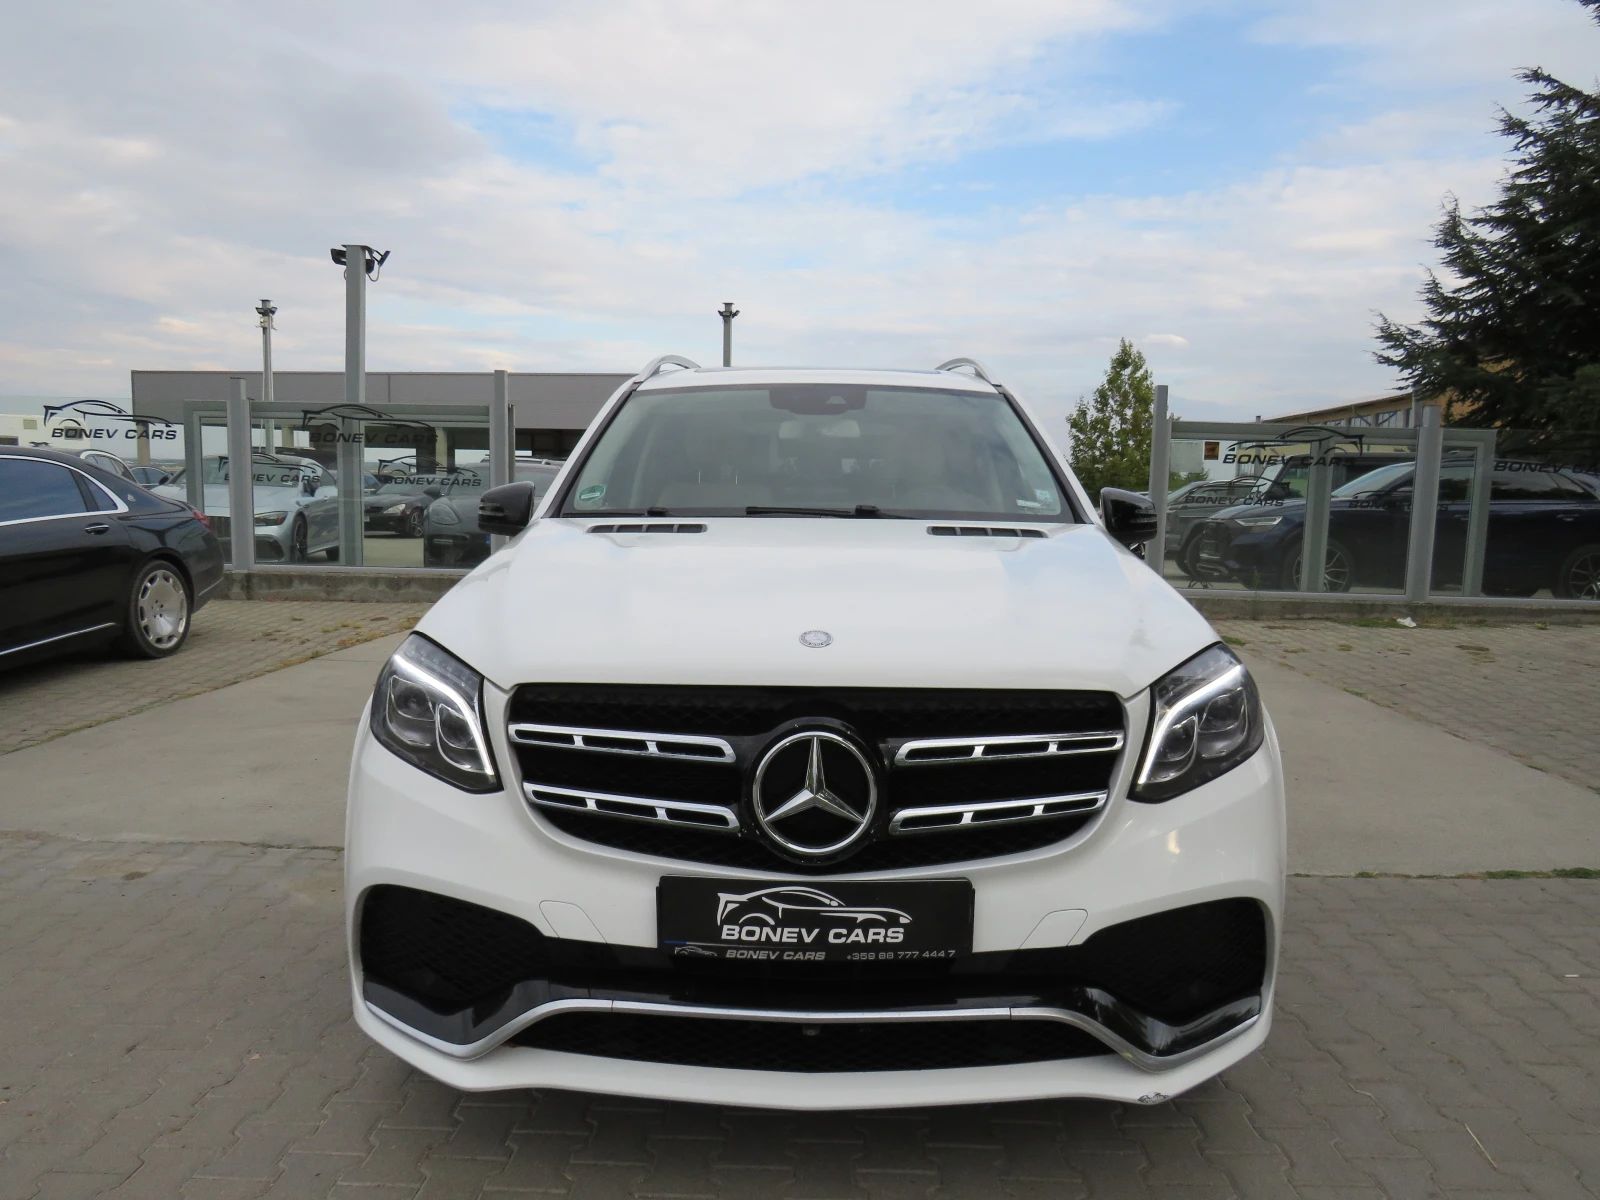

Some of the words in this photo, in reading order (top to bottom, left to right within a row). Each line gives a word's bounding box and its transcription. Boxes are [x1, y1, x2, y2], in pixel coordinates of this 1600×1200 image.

[51, 428, 118, 439] BONEV
[124, 429, 177, 440] CARS
[309, 432, 378, 444] BONEV
[384, 433, 439, 445] CARS
[1223, 454, 1292, 465] BONEV
[1301, 456, 1355, 468] CARS
[1493, 461, 1564, 473] BONEV
[280, 474, 320, 483] CARS
[387, 476, 436, 486] BONEV
[441, 478, 482, 487] CARS
[1184, 495, 1239, 505] BONEV
[1243, 498, 1284, 507] CARS
[721, 924, 820, 943] BONEV
[828, 927, 904, 944] CARS
[725, 949, 780, 960] BONEV
[783, 950, 826, 960] CARS
[847, 951, 876, 960] +359
[896, 951, 919, 959] 777
[922, 950, 945, 958] 444
[947, 949, 956, 958] 7
